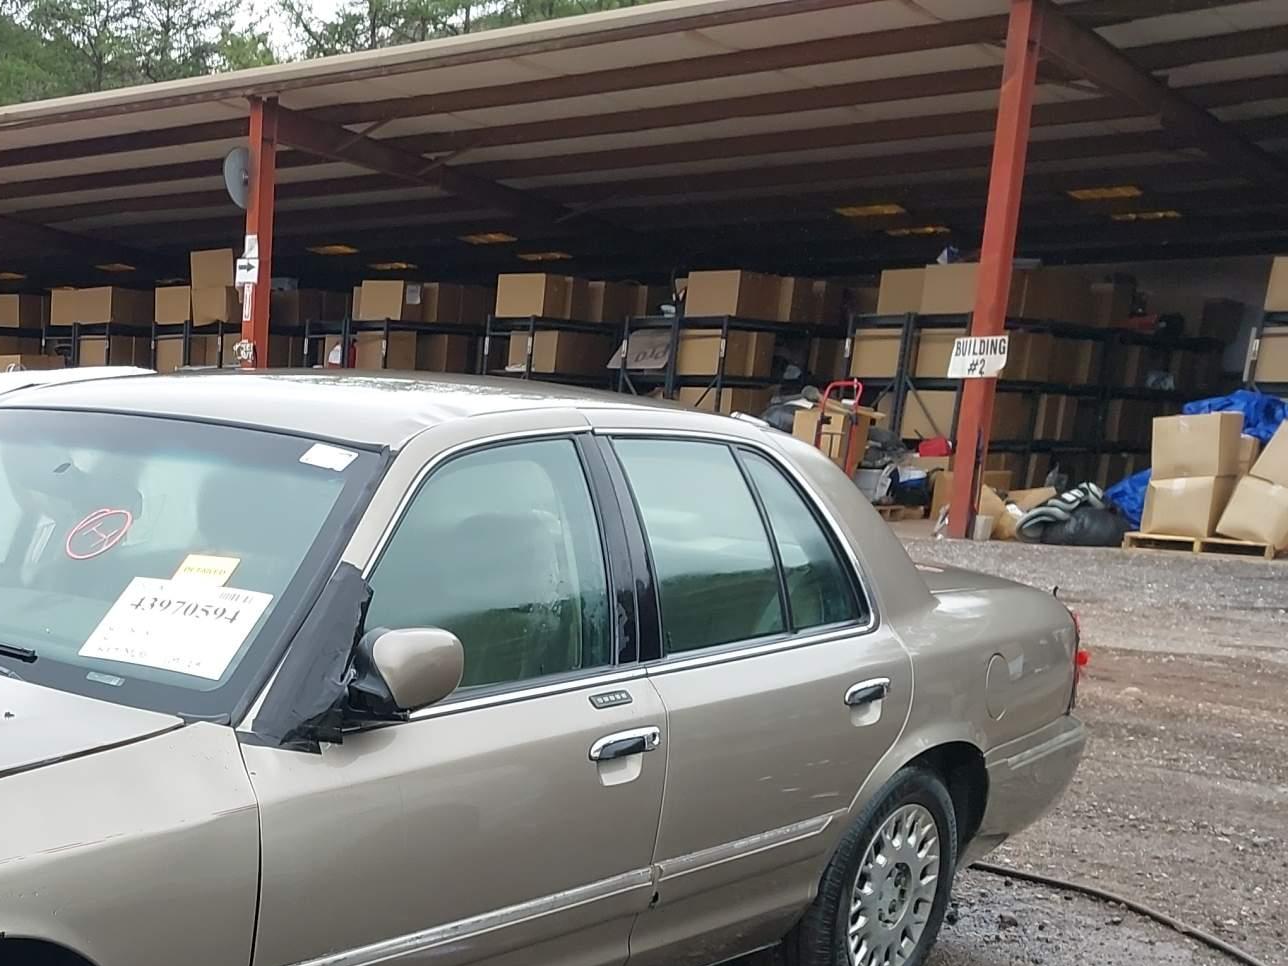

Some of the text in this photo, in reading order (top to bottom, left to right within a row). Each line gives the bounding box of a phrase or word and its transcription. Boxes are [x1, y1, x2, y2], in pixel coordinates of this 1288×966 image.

[955, 338, 1006, 356] BUILDING
[967, 358, 986, 376] #2
[130, 596, 240, 624] 43970594
